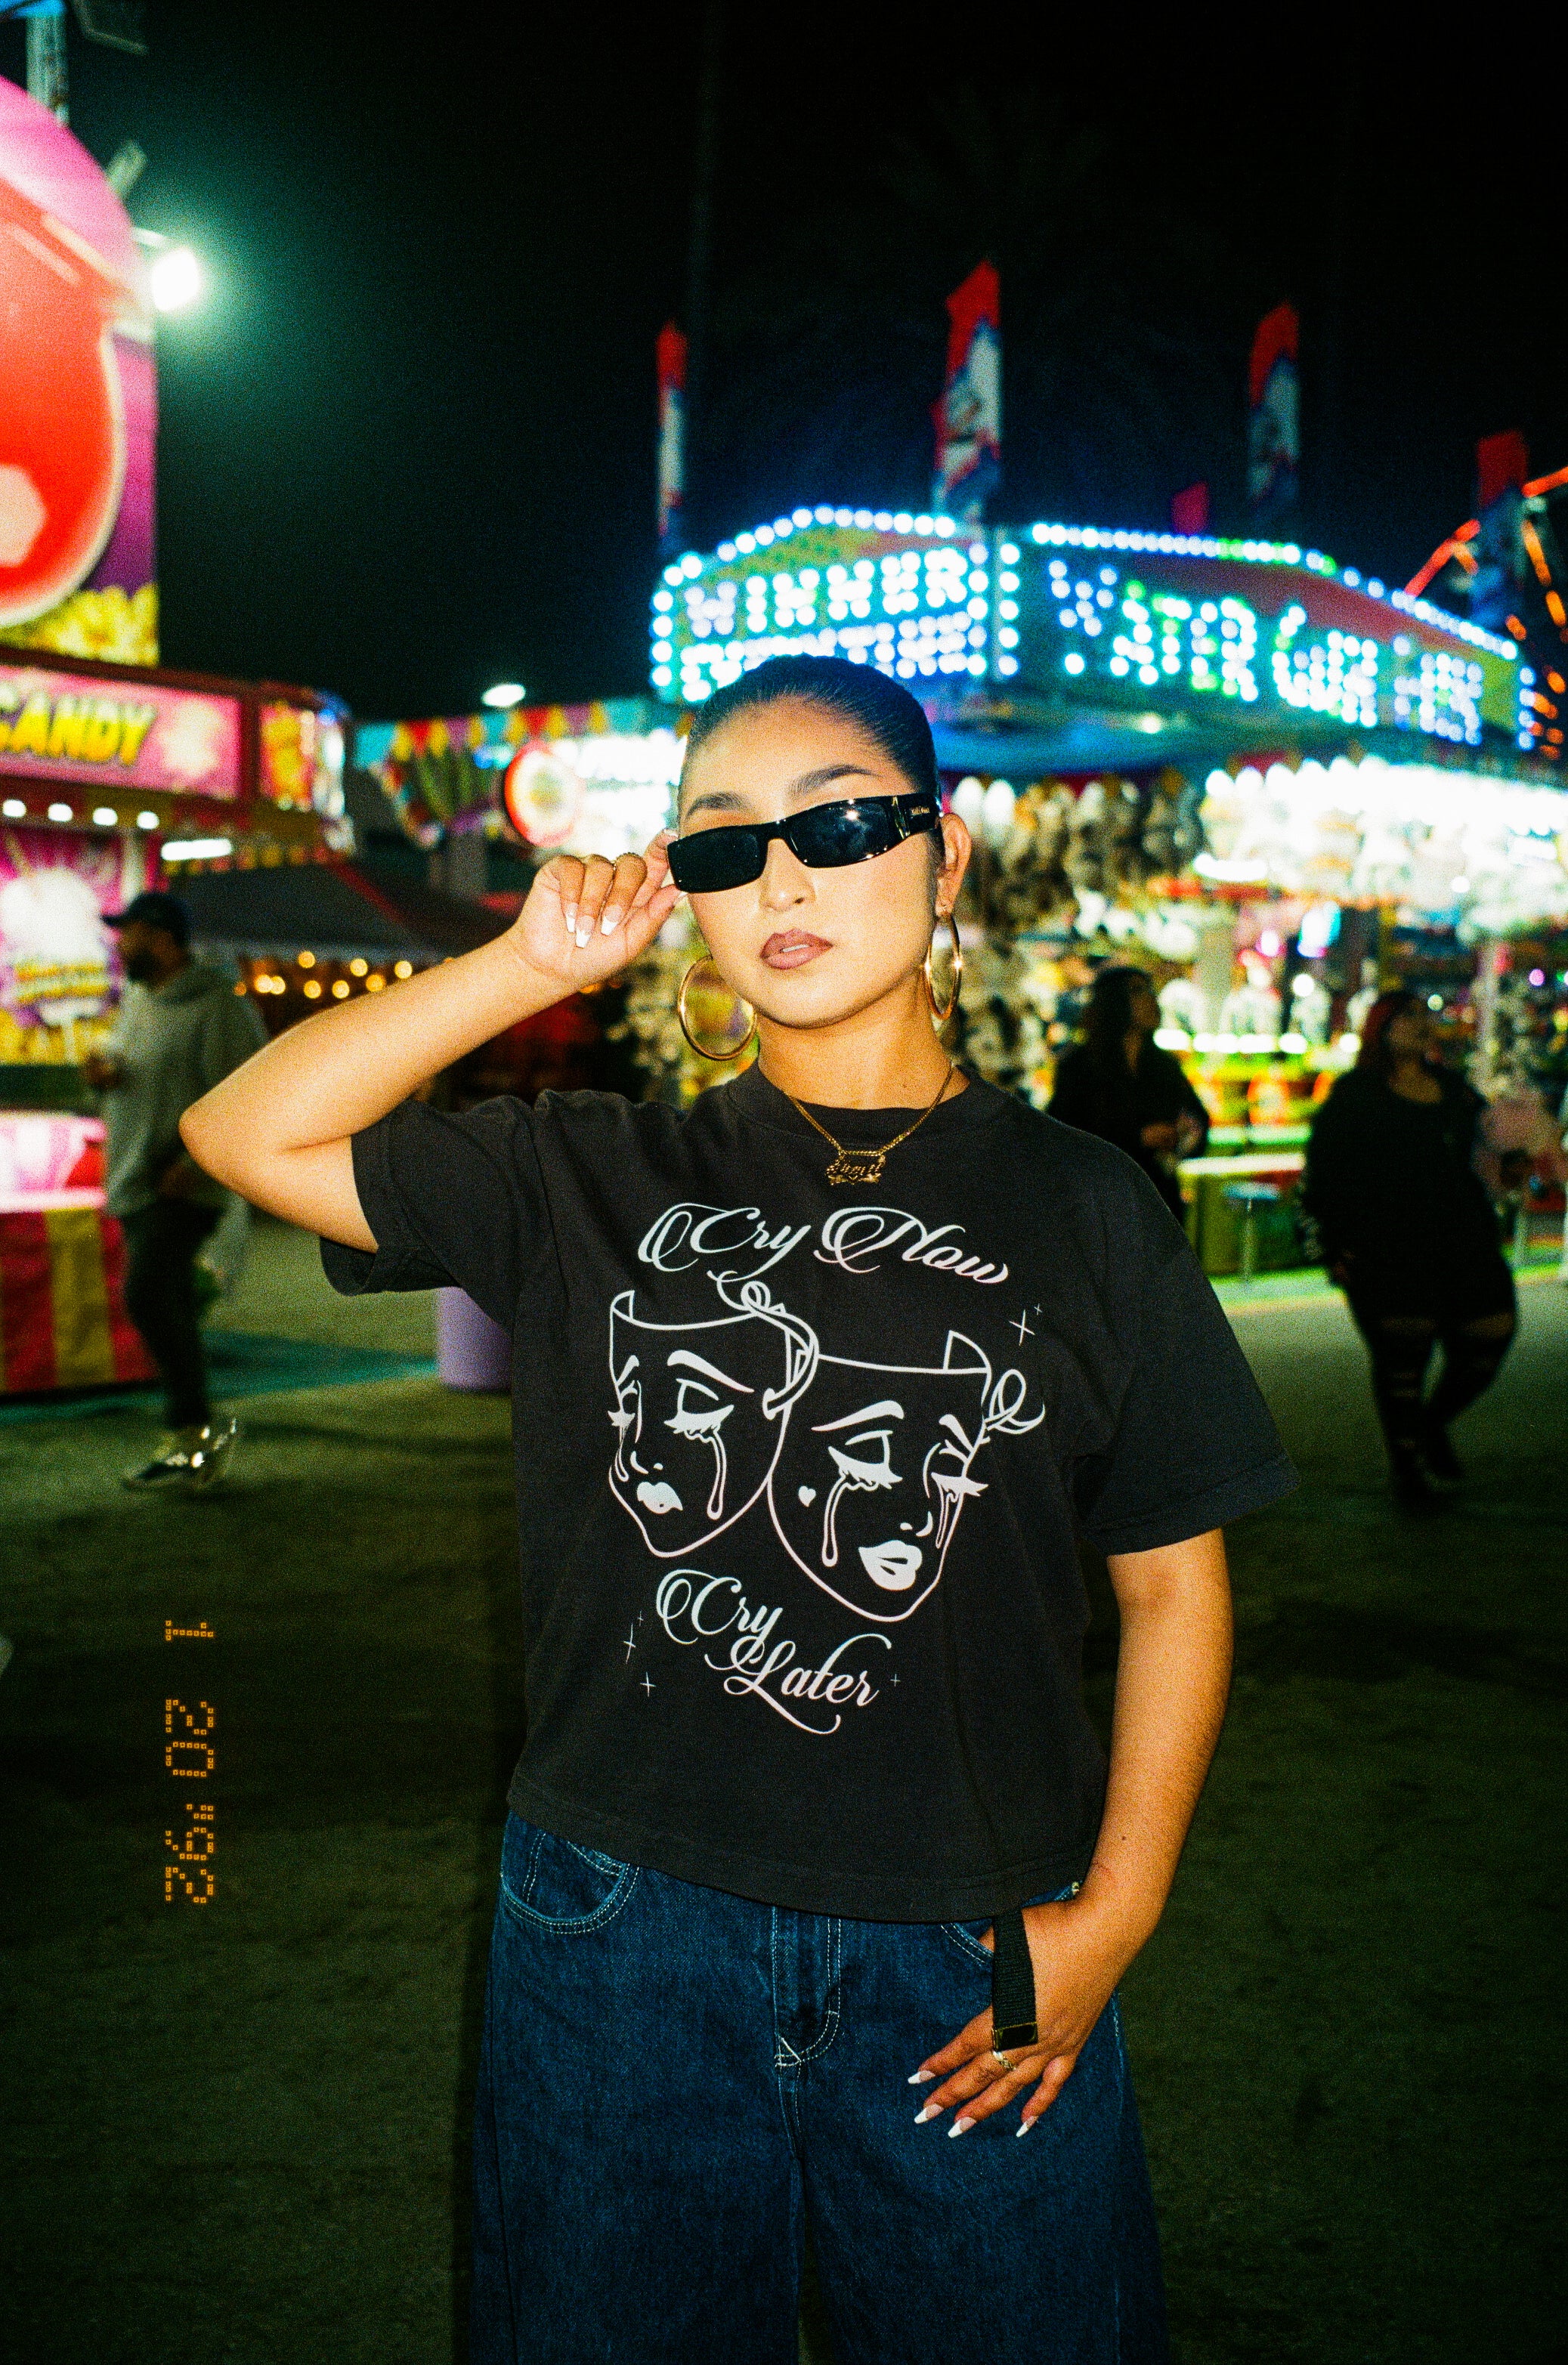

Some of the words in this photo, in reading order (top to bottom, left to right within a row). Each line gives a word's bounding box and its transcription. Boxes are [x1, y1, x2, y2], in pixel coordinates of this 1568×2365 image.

[684, 546, 968, 638] WINNER
[638, 1203, 811, 1283] Cry
[814, 1207, 1009, 1284] Now
[656, 1569, 783, 1670] Cry
[723, 1633, 892, 1735] Later
